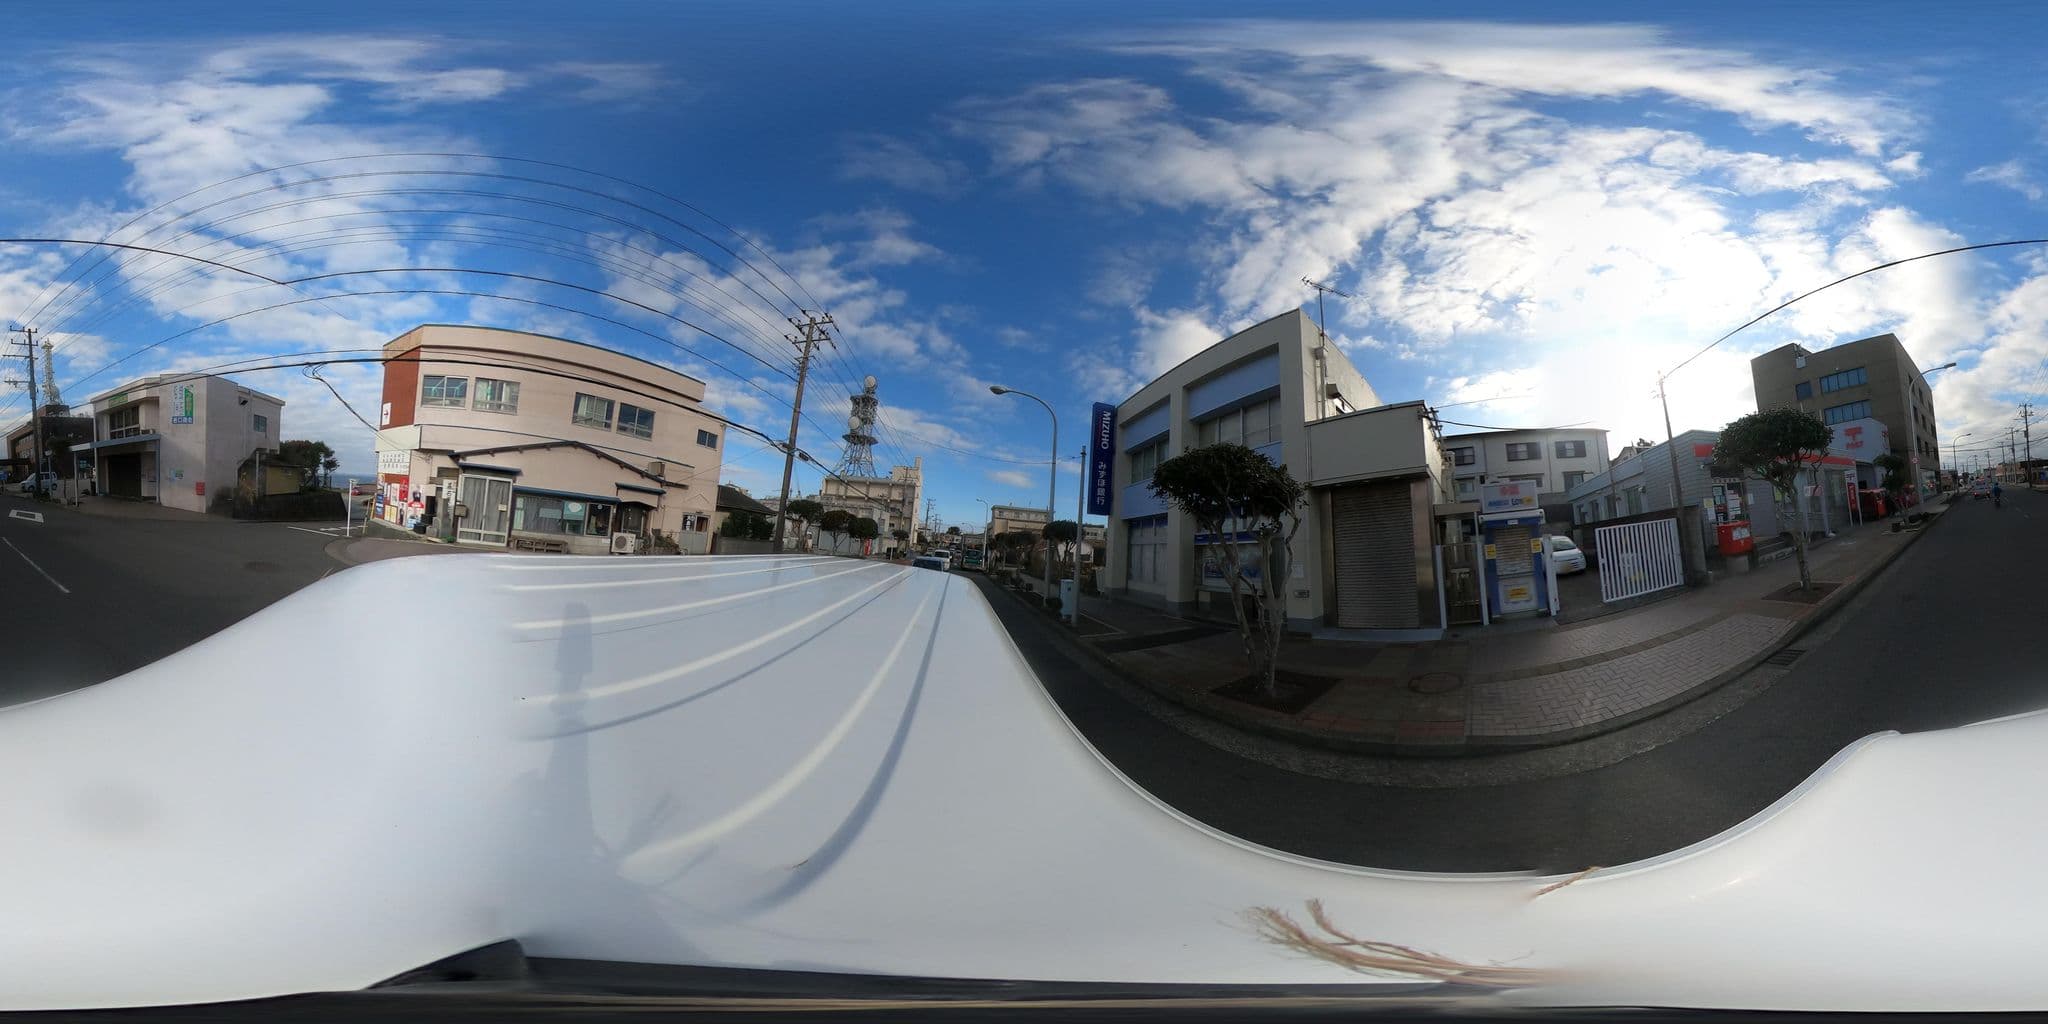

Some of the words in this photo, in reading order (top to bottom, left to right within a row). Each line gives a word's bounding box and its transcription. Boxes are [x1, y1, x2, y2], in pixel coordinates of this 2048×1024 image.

[1101, 411, 1111, 449] MIZUHO
[1097, 461, 1106, 505] みずほ銀行
